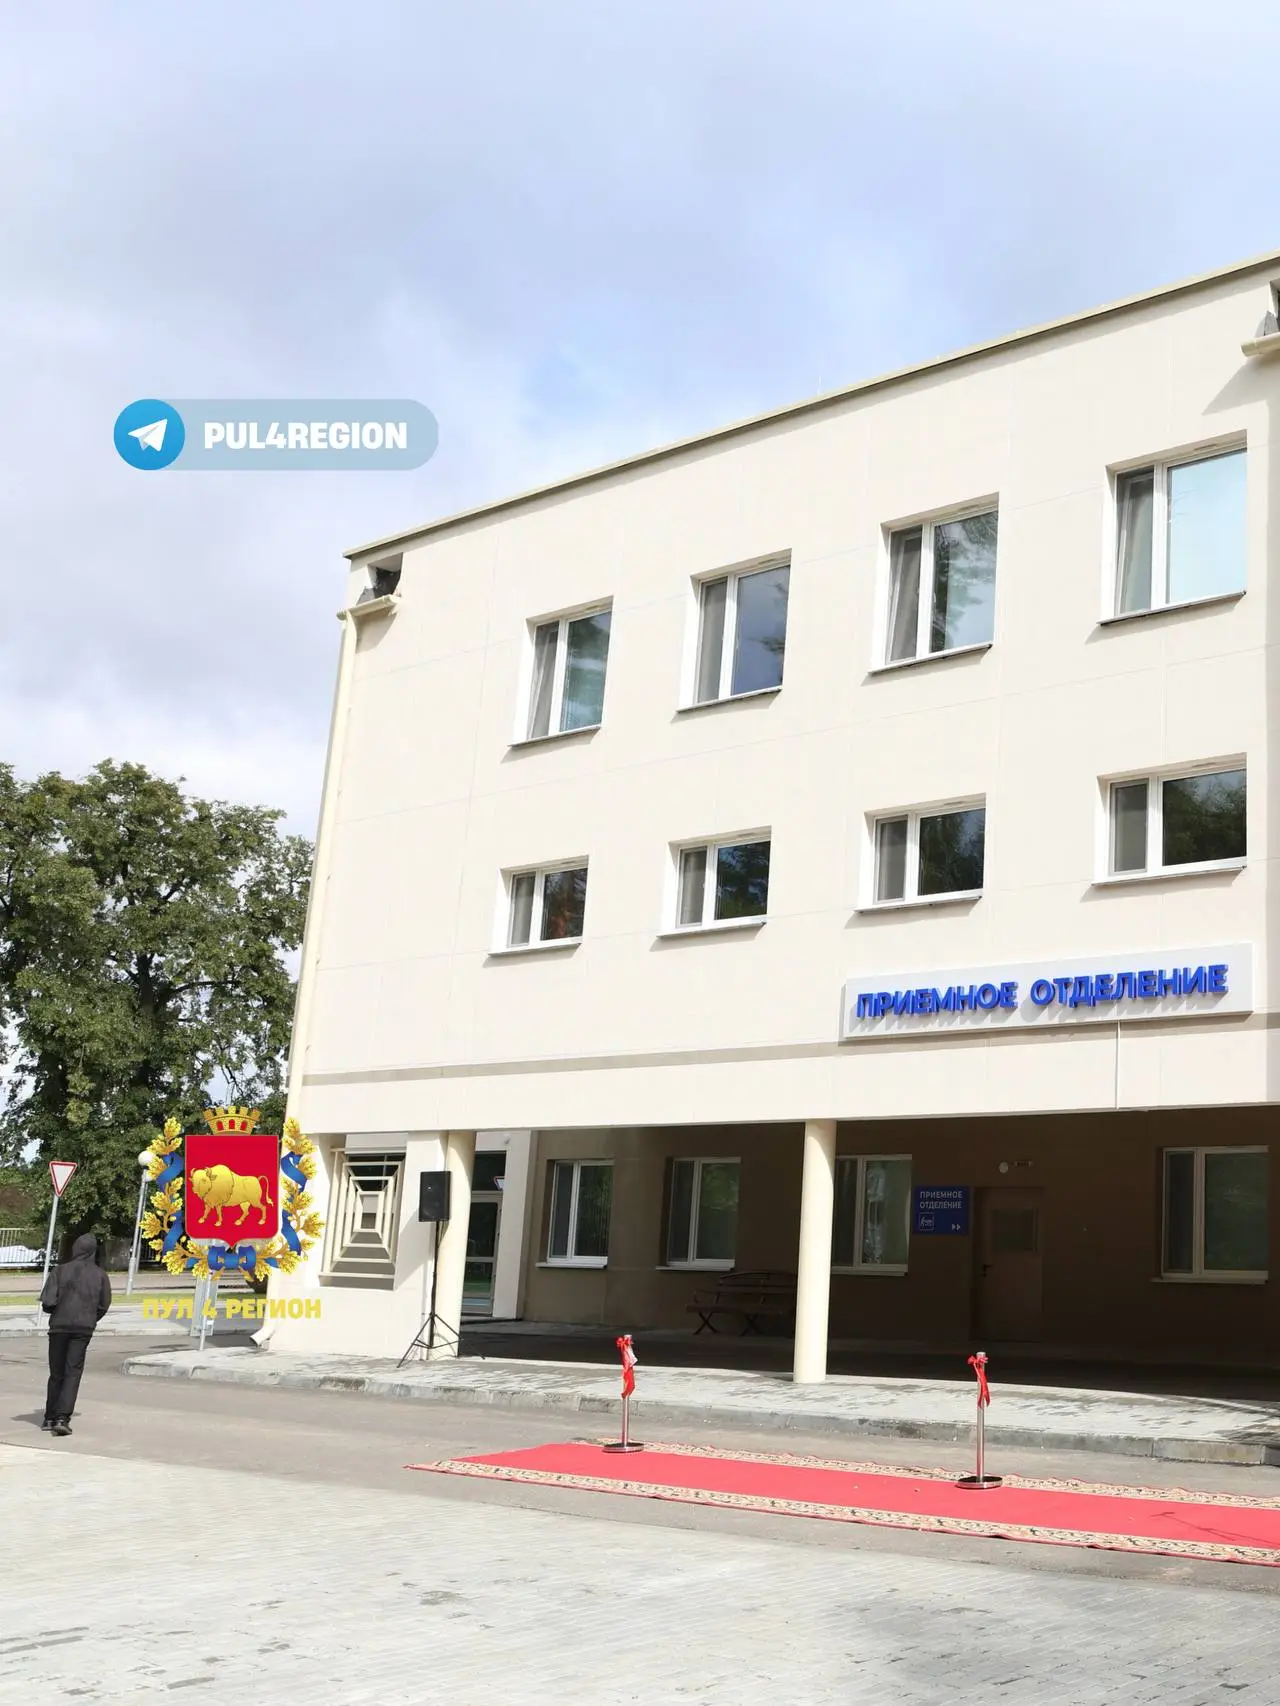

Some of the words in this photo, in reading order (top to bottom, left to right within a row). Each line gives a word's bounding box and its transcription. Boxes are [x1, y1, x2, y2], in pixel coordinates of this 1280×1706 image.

[857, 981, 1019, 1018] ПРИЕМНОЕ
[1030, 964, 1229, 1008] ОТДЕЛЕНИЕ
[920, 1191, 963, 1199] ПРИЕМНОЕ
[919, 1201, 962, 1210] ОТДЕЛЕНИЕ
